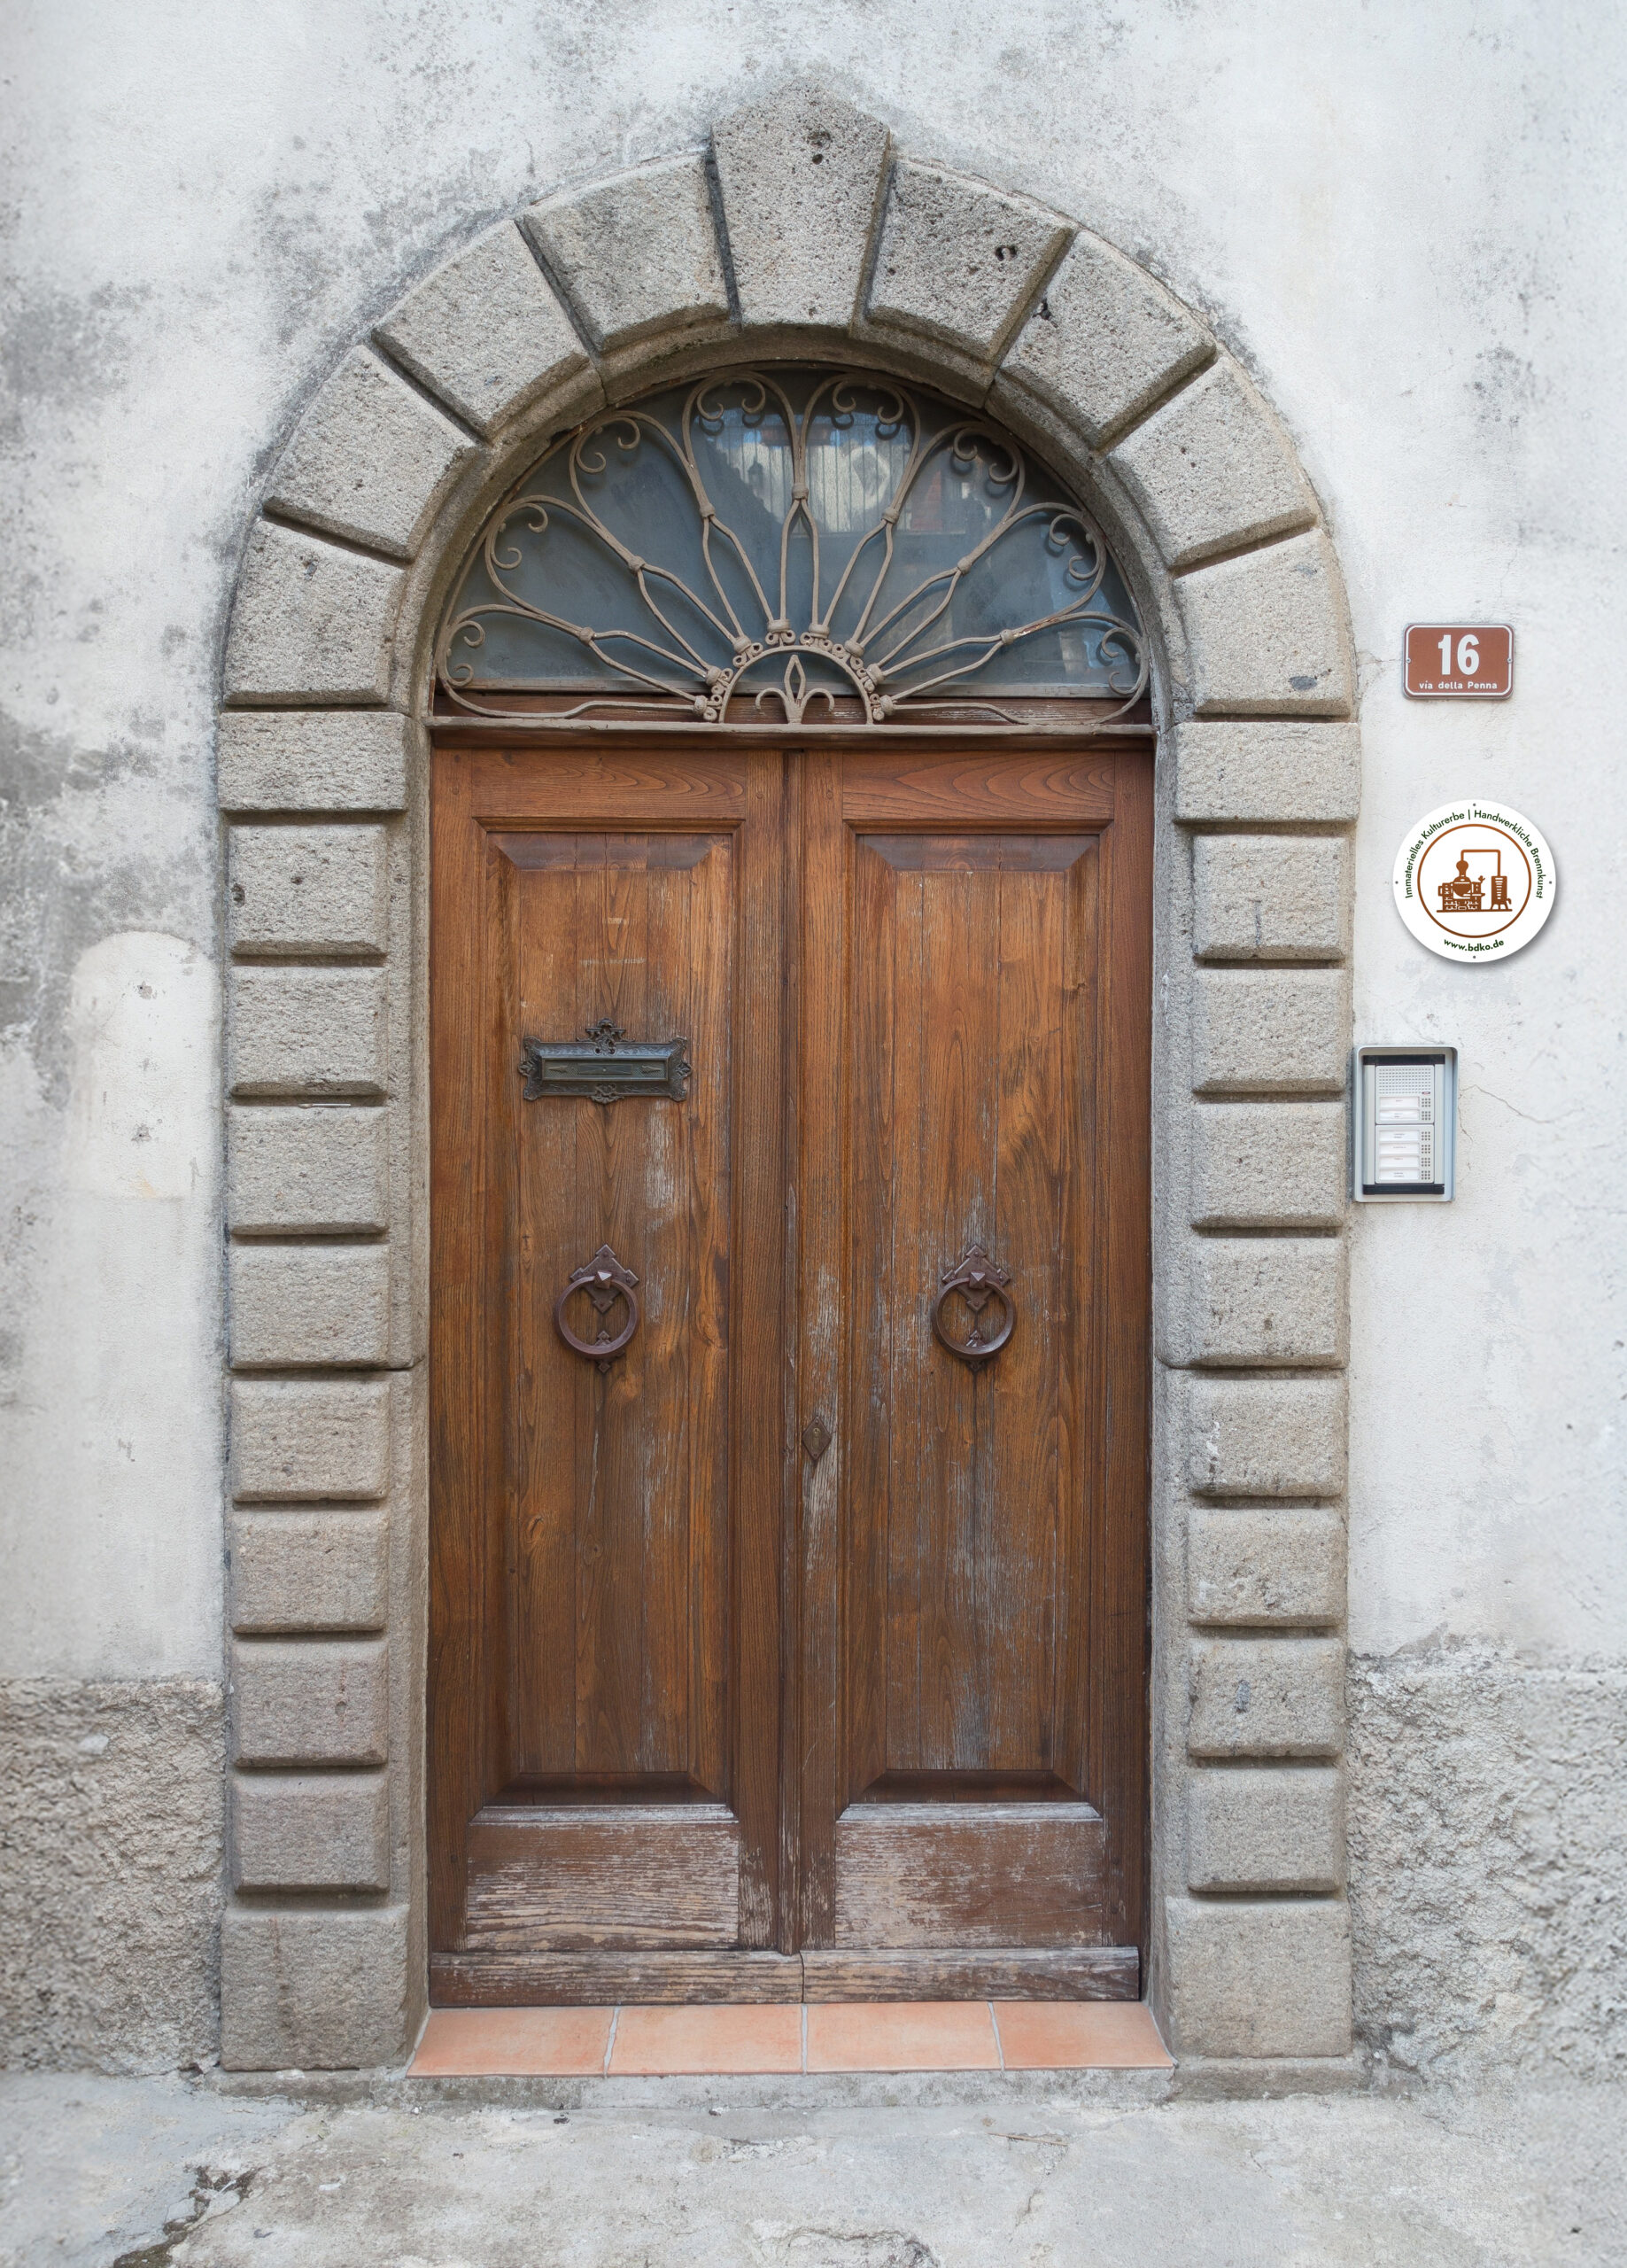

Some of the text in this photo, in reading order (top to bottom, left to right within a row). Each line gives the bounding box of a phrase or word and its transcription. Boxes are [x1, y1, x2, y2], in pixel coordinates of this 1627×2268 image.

[1438, 634, 1479, 675] 16
[1419, 680, 1433, 689] via
[1406, 840, 1424, 898] Immaterielles
[1422, 812, 1465, 840] Kulturerbe
[1474, 810, 1532, 847] Handwerkliche
[1530, 848, 1546, 898] Brennkunst
[1444, 939, 1504, 951] www.bdko.de
